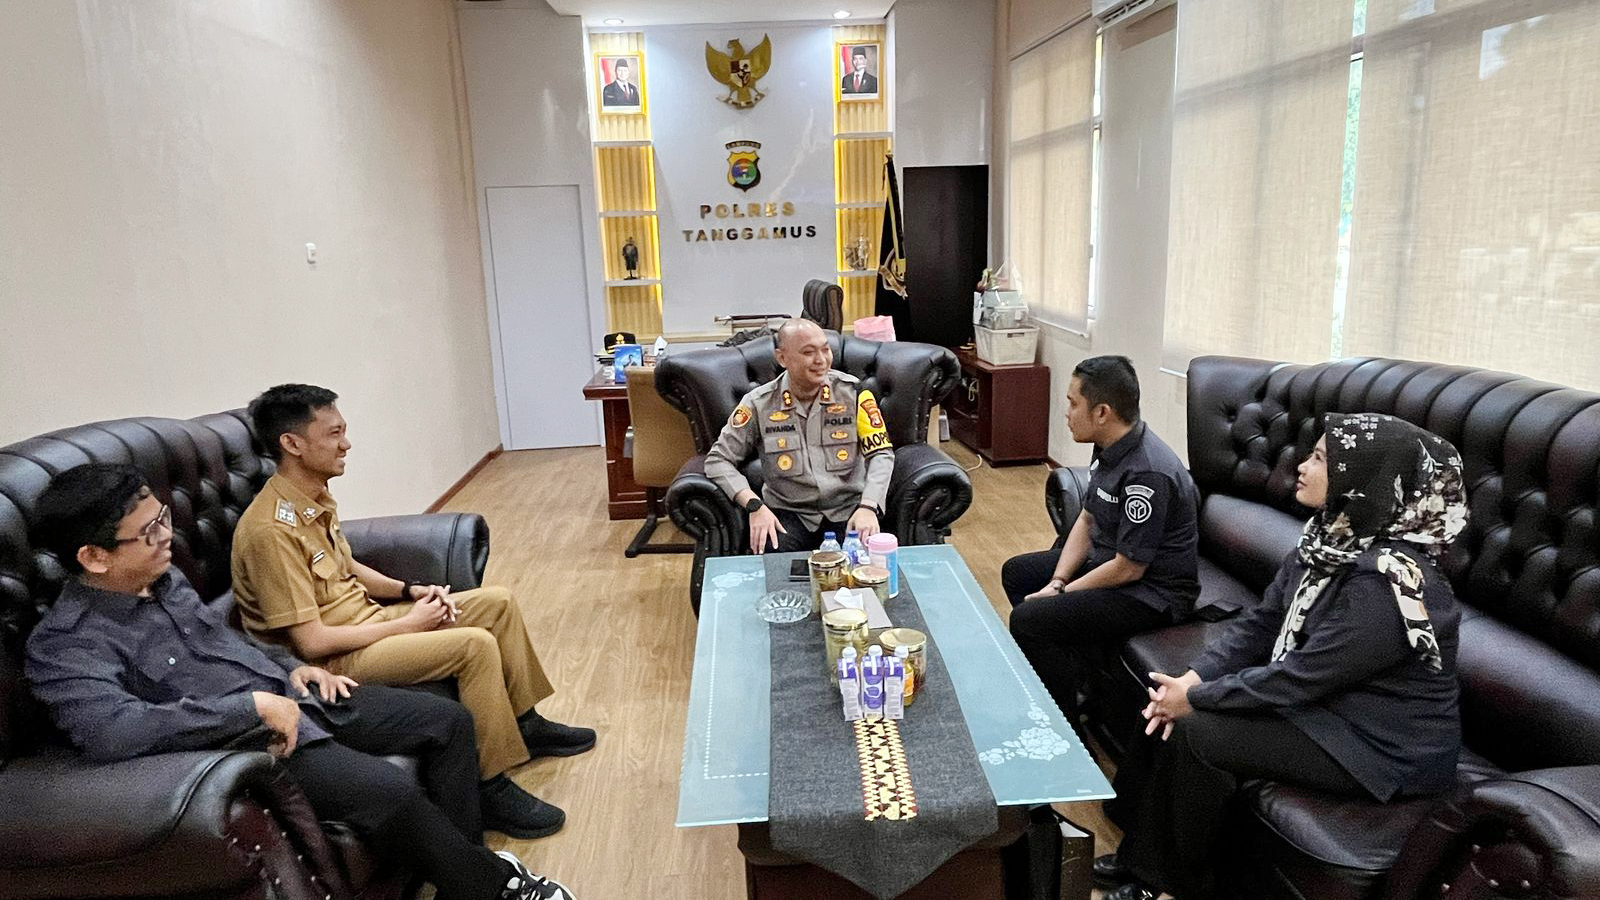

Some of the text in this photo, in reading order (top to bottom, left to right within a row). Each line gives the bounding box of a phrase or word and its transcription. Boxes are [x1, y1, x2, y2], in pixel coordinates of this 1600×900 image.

[700, 202, 795, 219] POLRES
[682, 225, 817, 242] TANGGAMUS
[765, 424, 796, 434] RIVANDA
